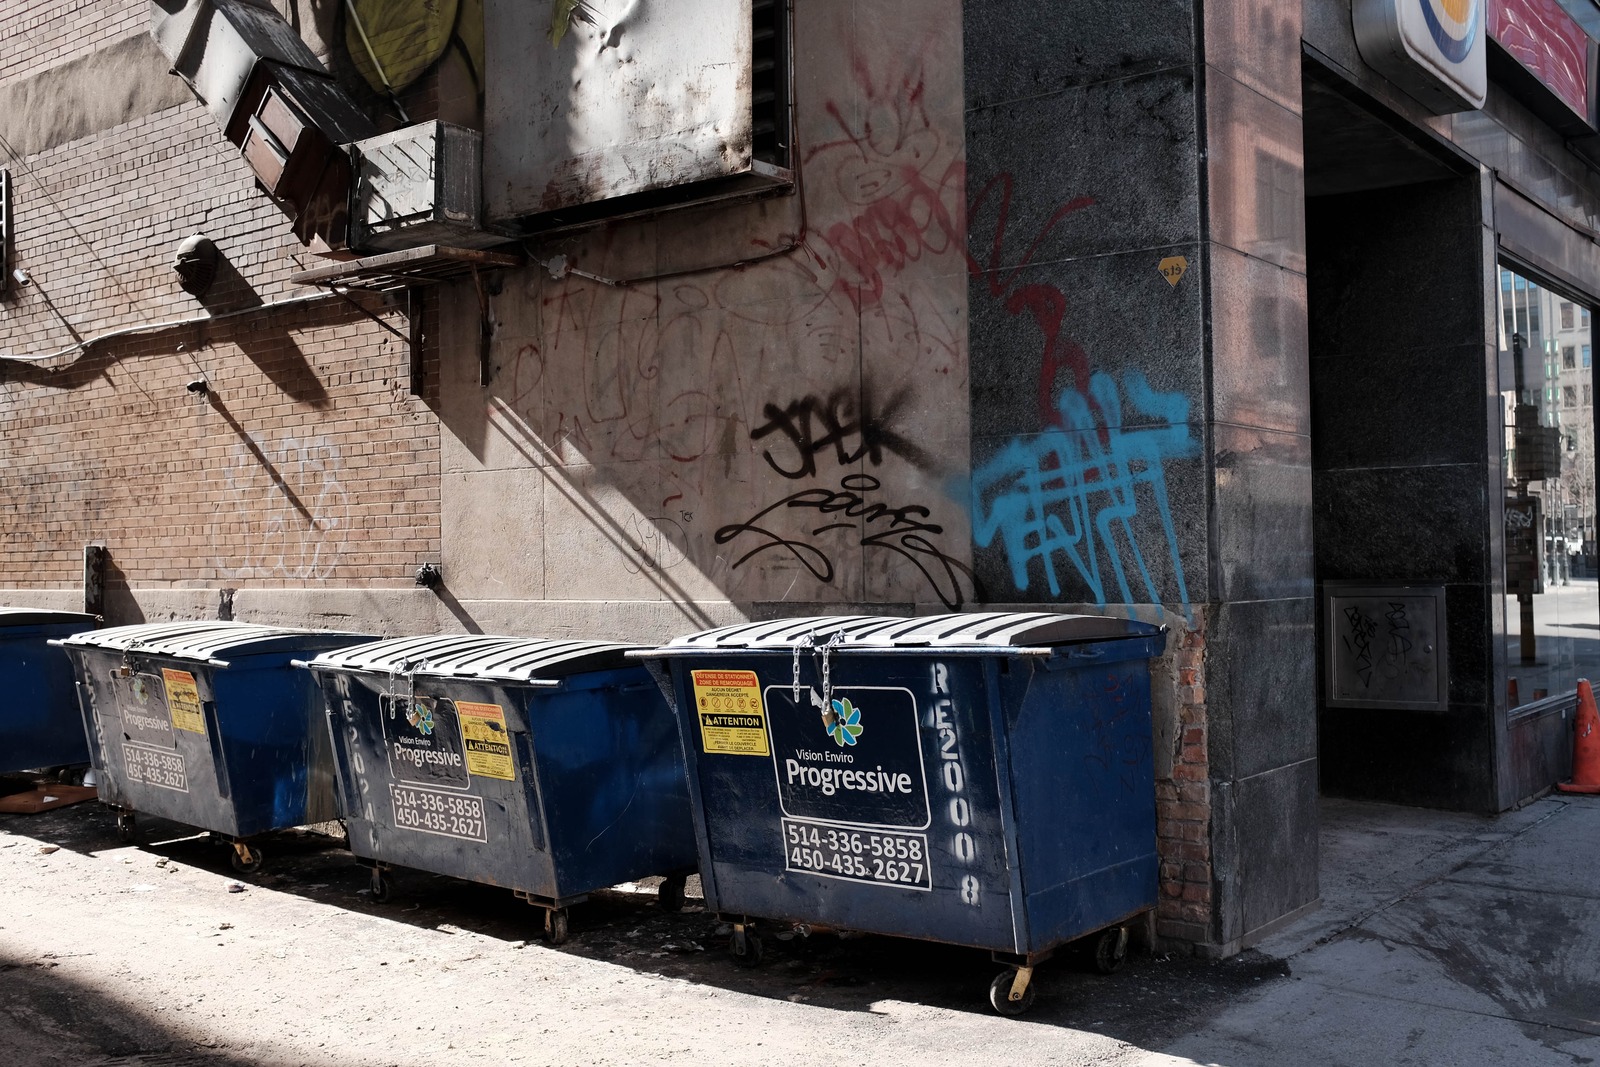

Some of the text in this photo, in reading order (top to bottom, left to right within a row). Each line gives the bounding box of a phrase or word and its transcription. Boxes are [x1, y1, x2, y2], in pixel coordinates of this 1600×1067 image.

[123, 709, 170, 732] Progressive
[713, 717, 760, 726] ATTENTION
[399, 735, 432, 746] Vision Enviro
[125, 748, 183, 773] 514-336-5858
[393, 742, 462, 768] Progressive
[795, 749, 854, 764] Vision Enviro
[785, 758, 912, 796] Progressive
[394, 789, 481, 818] 514-336-5858
[397, 808, 482, 837] 450-435-2627
[788, 824, 923, 861] 514-336-5858
[791, 847, 923, 884] 450-4352627
